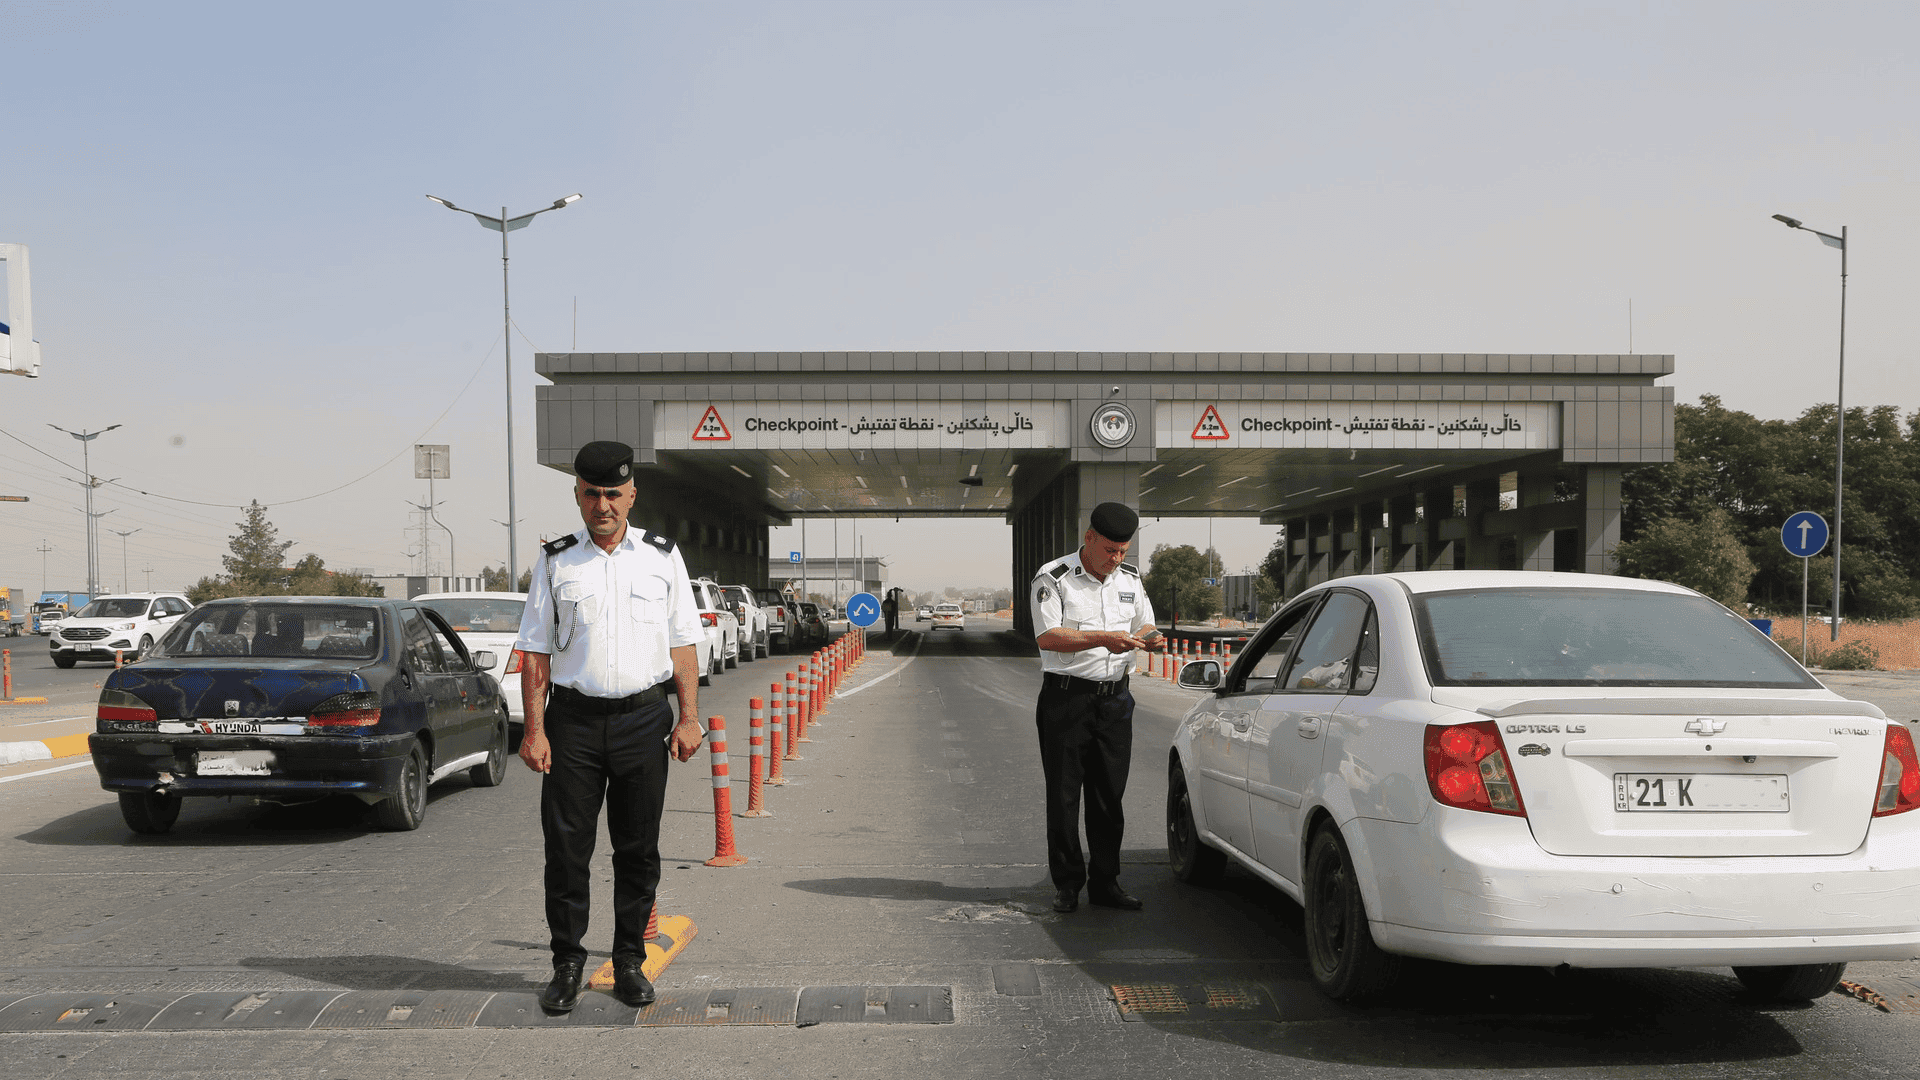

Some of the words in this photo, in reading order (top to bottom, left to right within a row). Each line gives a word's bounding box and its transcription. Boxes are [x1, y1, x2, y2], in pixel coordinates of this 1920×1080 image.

[745, 417, 839, 434] Checkpoint
[850, 416, 897, 435] تفتيش
[899, 417, 934, 431] نقطة
[1241, 417, 1333, 434] Checkpoint
[1343, 416, 1389, 434] تفتيش
[1391, 417, 1426, 431] نقطة
[215, 723, 262, 733] HYUNDAI
[1505, 724, 1561, 734] OPTRA
[1565, 724, 1587, 734] LS
[1636, 778, 1667, 807] 21
[1678, 778, 1694, 807] K
